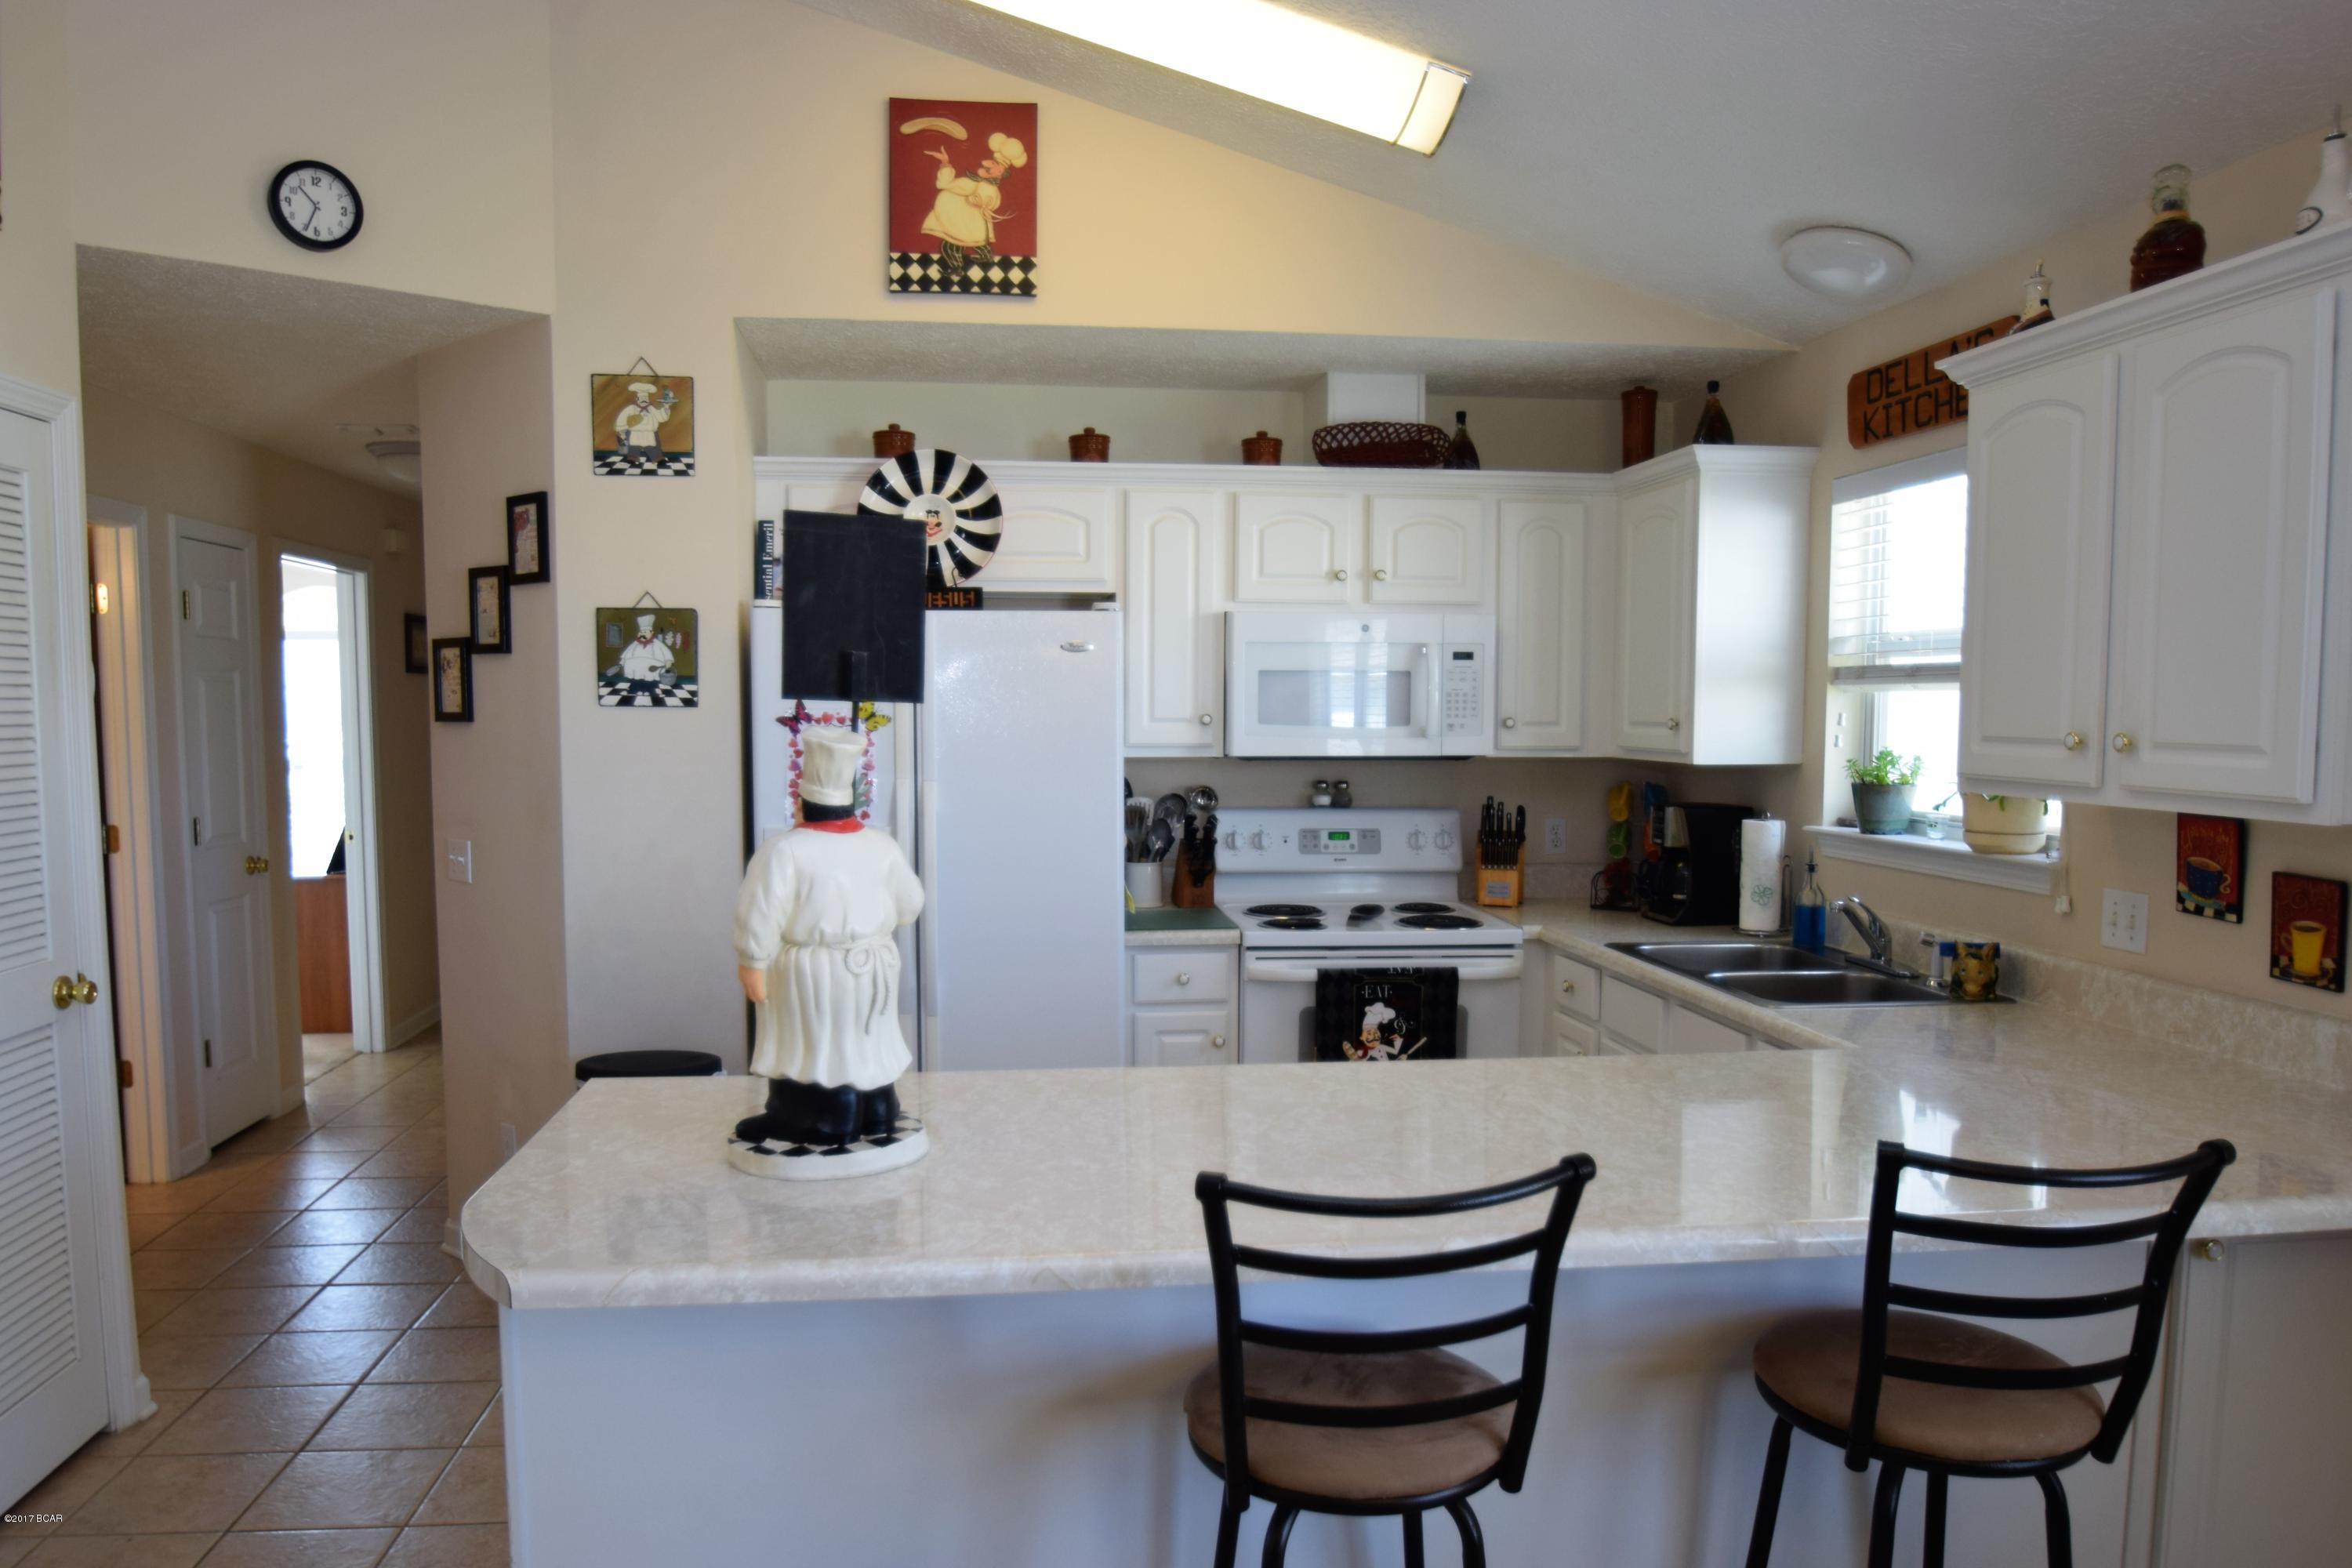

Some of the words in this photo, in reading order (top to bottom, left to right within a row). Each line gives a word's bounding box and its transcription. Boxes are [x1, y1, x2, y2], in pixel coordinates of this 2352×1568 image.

[311, 176, 321, 187] 12
[289, 186, 298, 195] 10
[285, 196, 292, 207] 9
[289, 212, 296, 220] 8
[341, 206, 347, 217] 3
[314, 227, 321, 237] 6
[1864, 383, 1969, 444] KITCHE
[763, 523, 774, 561] Emeril
[1364, 985, 1391, 998] EAT
